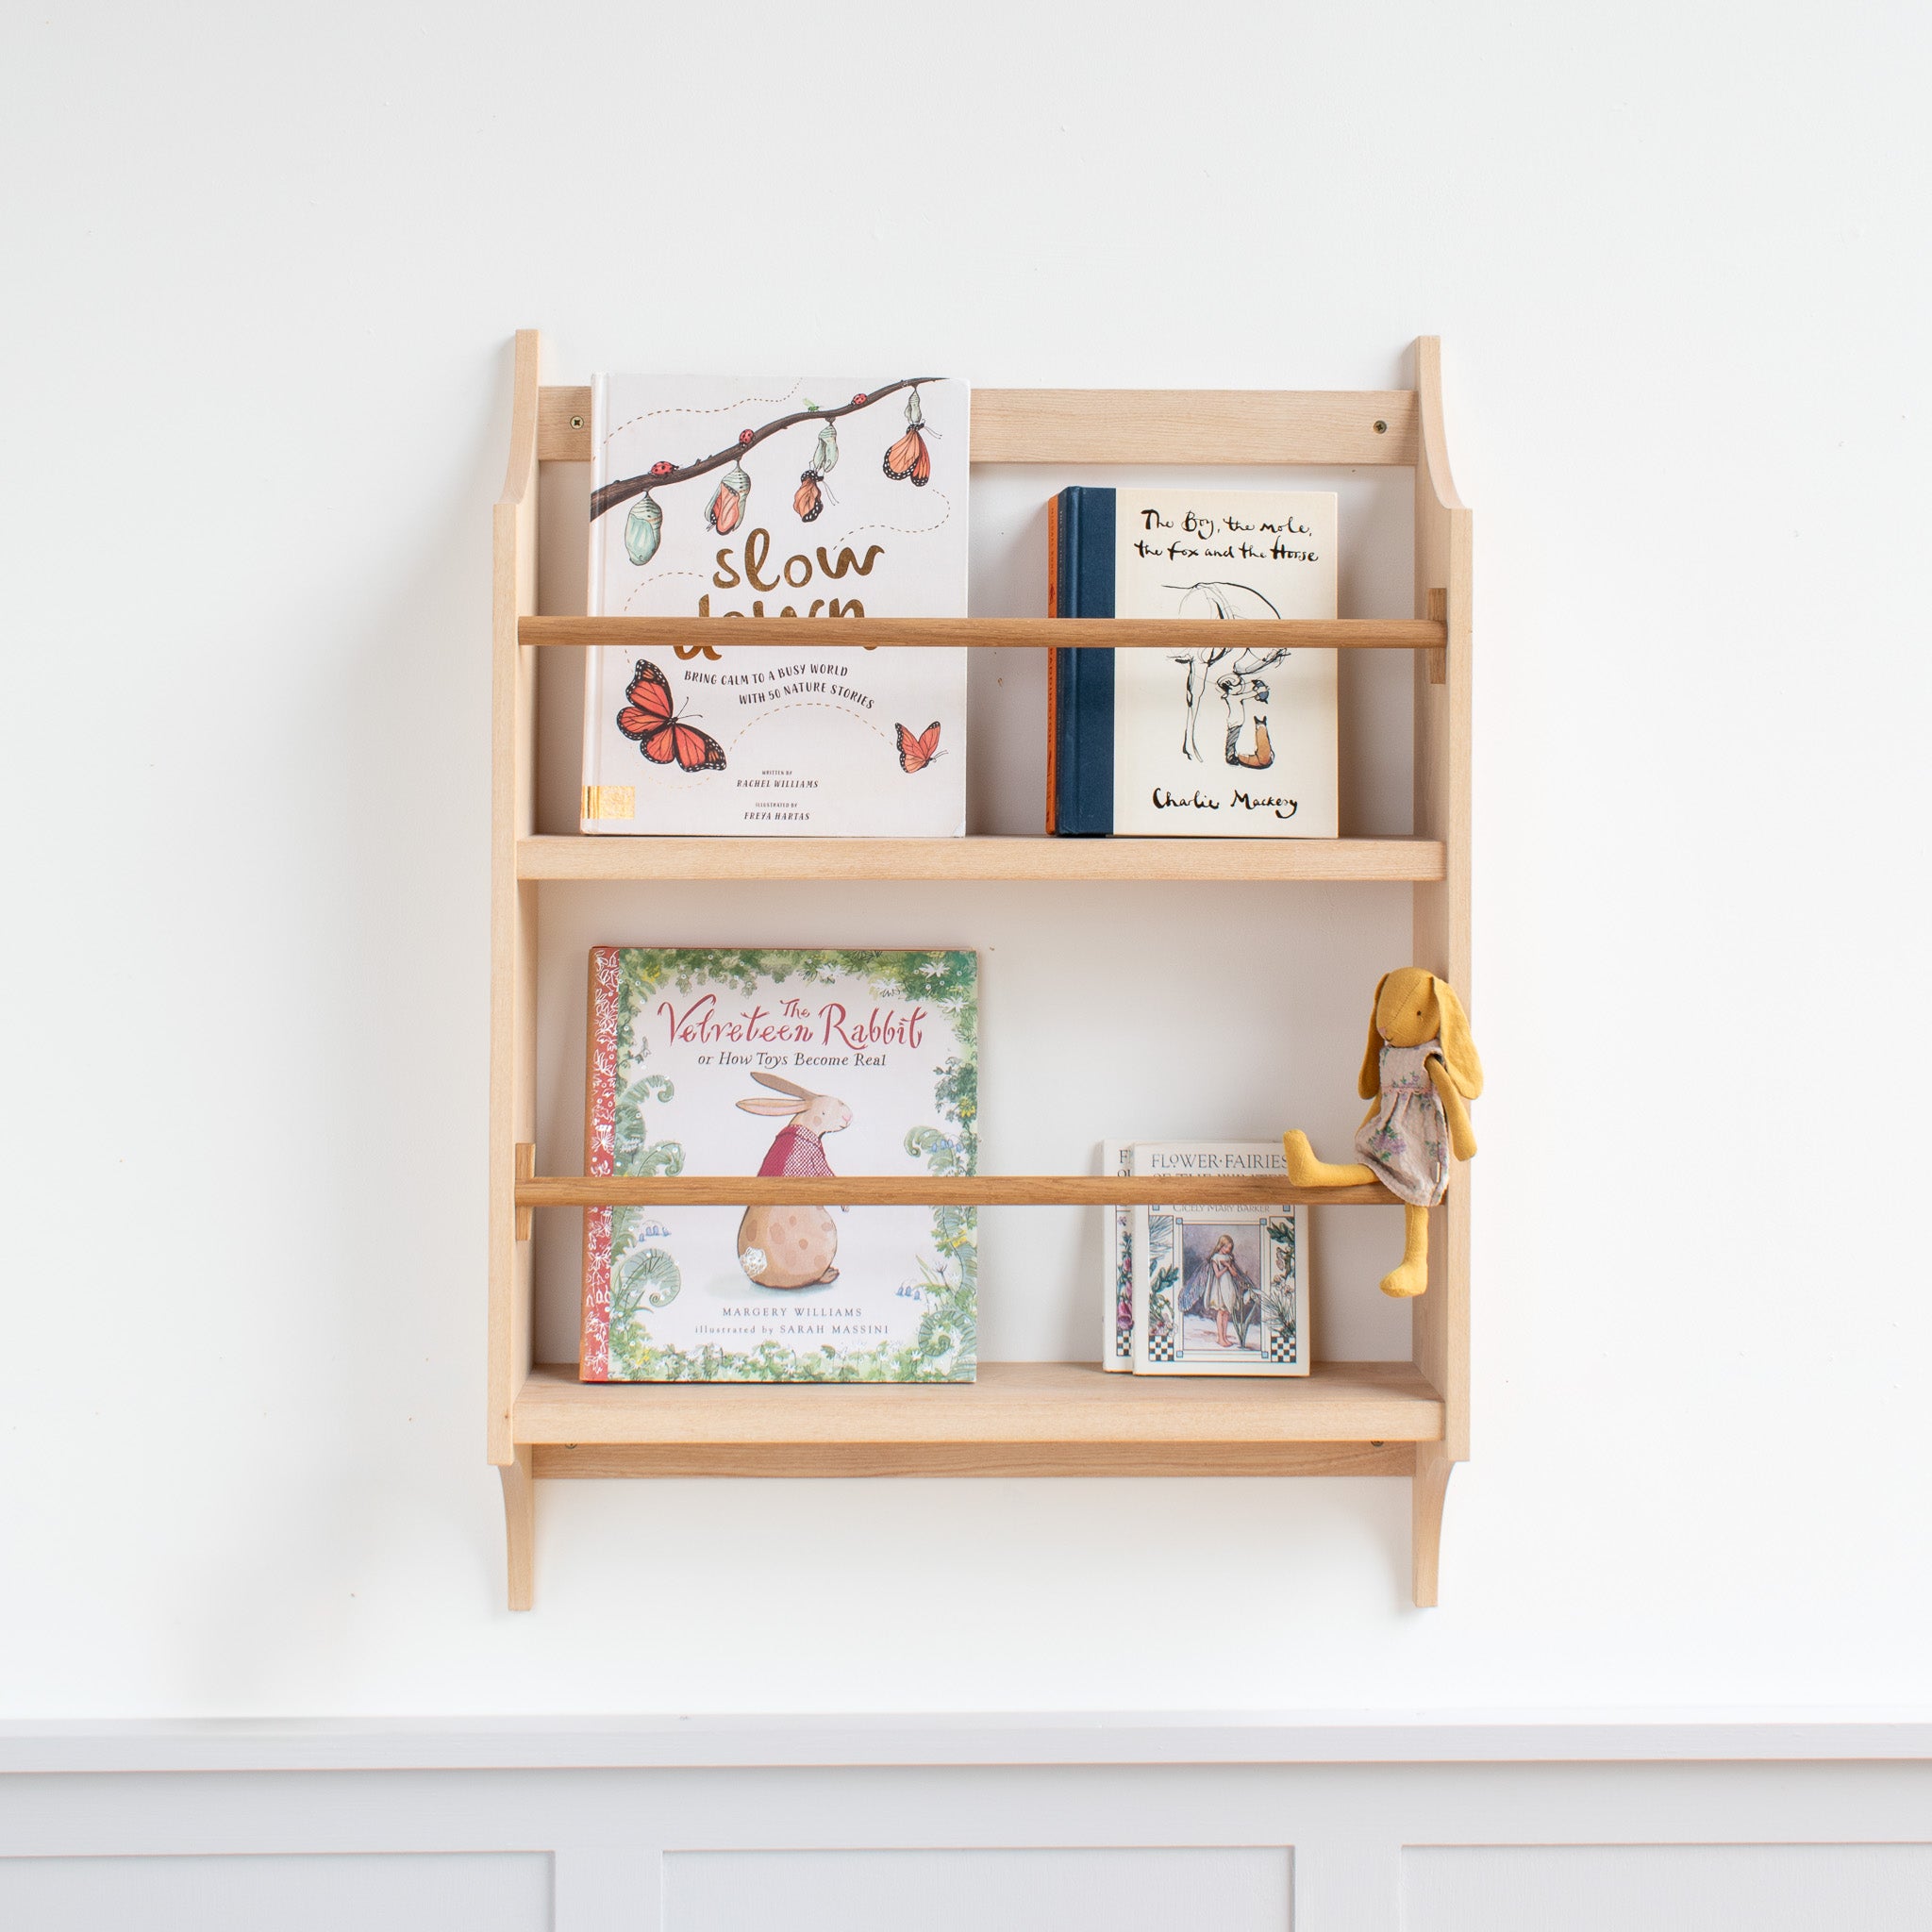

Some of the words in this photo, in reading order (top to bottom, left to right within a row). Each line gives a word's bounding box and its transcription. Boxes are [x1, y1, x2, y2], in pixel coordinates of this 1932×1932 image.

[1141, 509, 1174, 529] The
[1181, 510, 1220, 540] Boy,
[1223, 516, 1255, 531] the
[1134, 540, 1162, 558] the
[1168, 541, 1199, 560] fox
[1205, 546, 1235, 558] and
[1239, 542, 1267, 558] the
[1270, 535, 1319, 561] Horse
[713, 528, 885, 591] slow
[684, 670, 717, 684] BRING
[722, 675, 749, 685] CALM
[753, 673, 765, 684] TO
[768, 671, 775, 681] A
[778, 664, 806, 678] BUSY
[810, 664, 848, 676] WORLD
[740, 692, 765, 705] WITH
[769, 690, 781, 700] 50
[784, 682, 826, 695] NATURE
[830, 685, 874, 708] STORIES
[1153, 788, 1220, 809] Charlie
[779, 998, 810, 1019] The
[658, 993, 814, 1046] Velveteen
[818, 1003, 928, 1050] Rabbit
[698, 1056, 714, 1064] or
[718, 1052, 753, 1065] How
[757, 1052, 788, 1069] Toys
[794, 1053, 849, 1065] Become
[854, 1054, 887, 1066] Real
[723, 1307, 788, 1317] MARGERY
[794, 1307, 862, 1317] WILLIAMS
[695, 1325, 756, 1334] illustrated
[762, 1325, 774, 1335] by
[780, 1325, 824, 1334] SARAH
[832, 1325, 889, 1334] MASSINI
